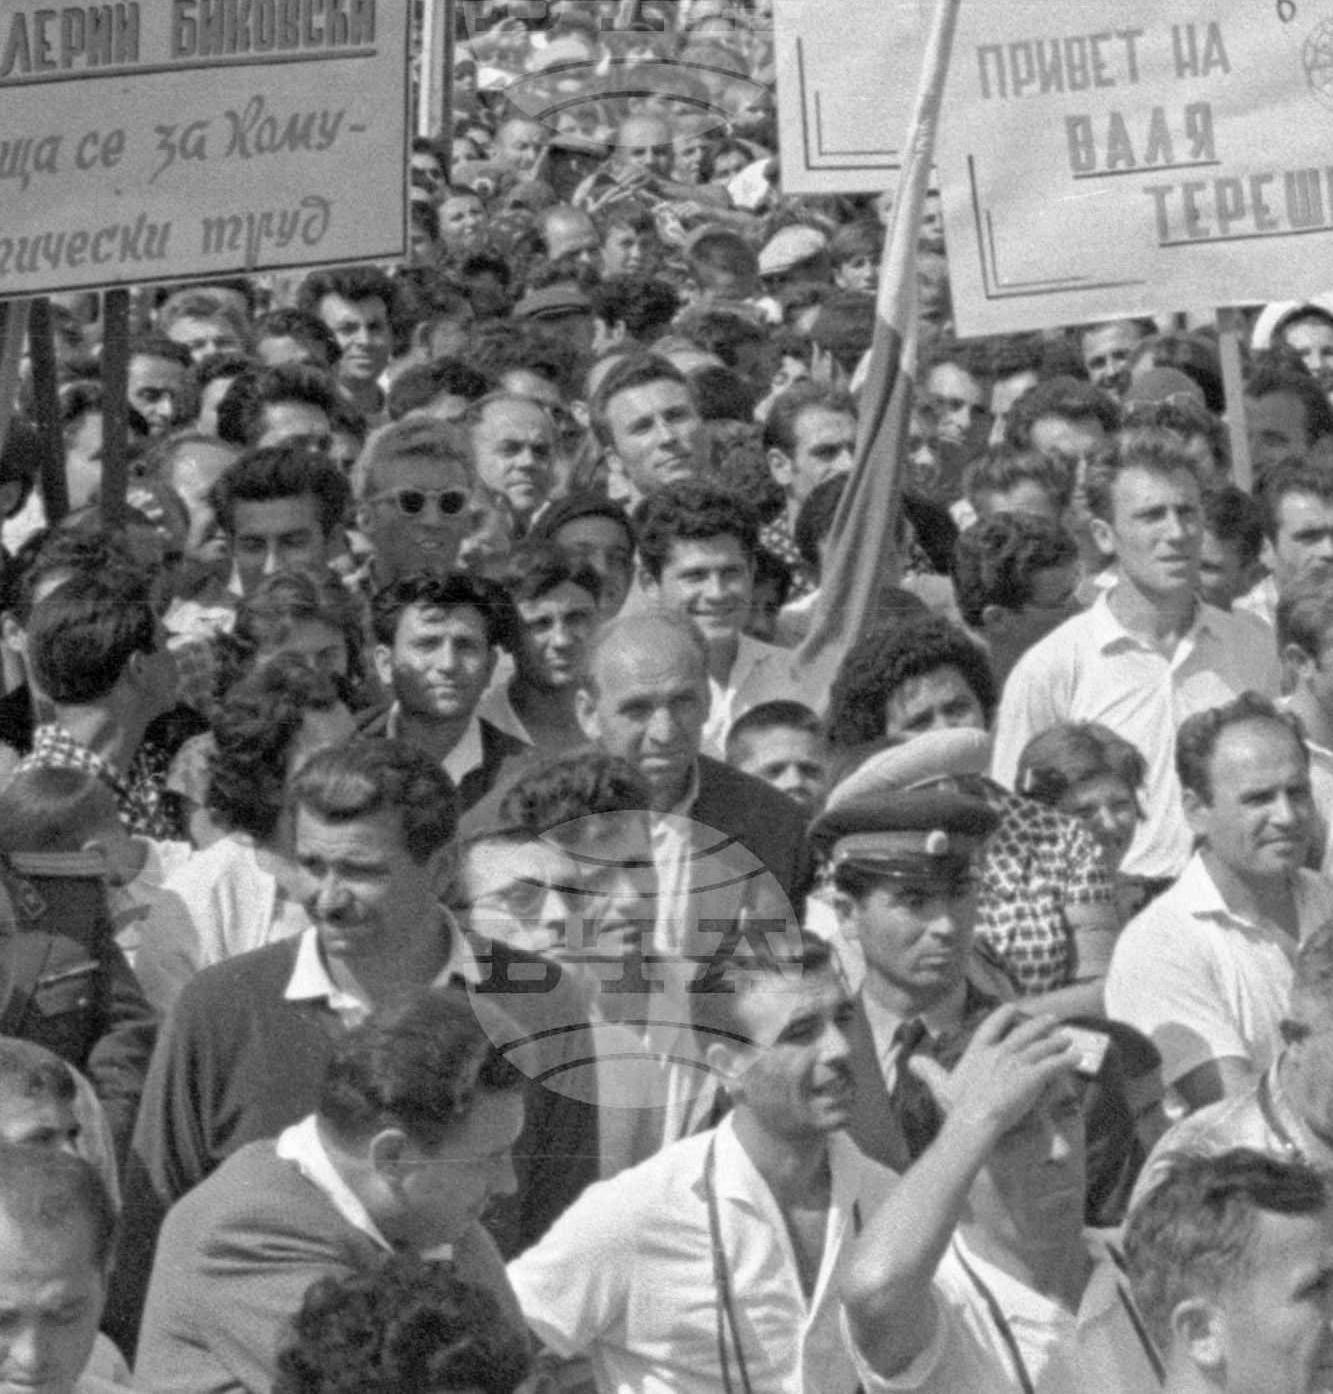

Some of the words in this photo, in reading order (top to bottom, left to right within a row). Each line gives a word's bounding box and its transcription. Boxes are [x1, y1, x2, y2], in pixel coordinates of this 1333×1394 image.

[977, 29, 1144, 98] ПРИВЕТ
[1172, 21, 1232, 79] НА
[75, 127, 126, 172] се
[148, 121, 210, 185] за
[1064, 101, 1218, 173] ВАЛЯ
[201, 195, 334, 268] труд
